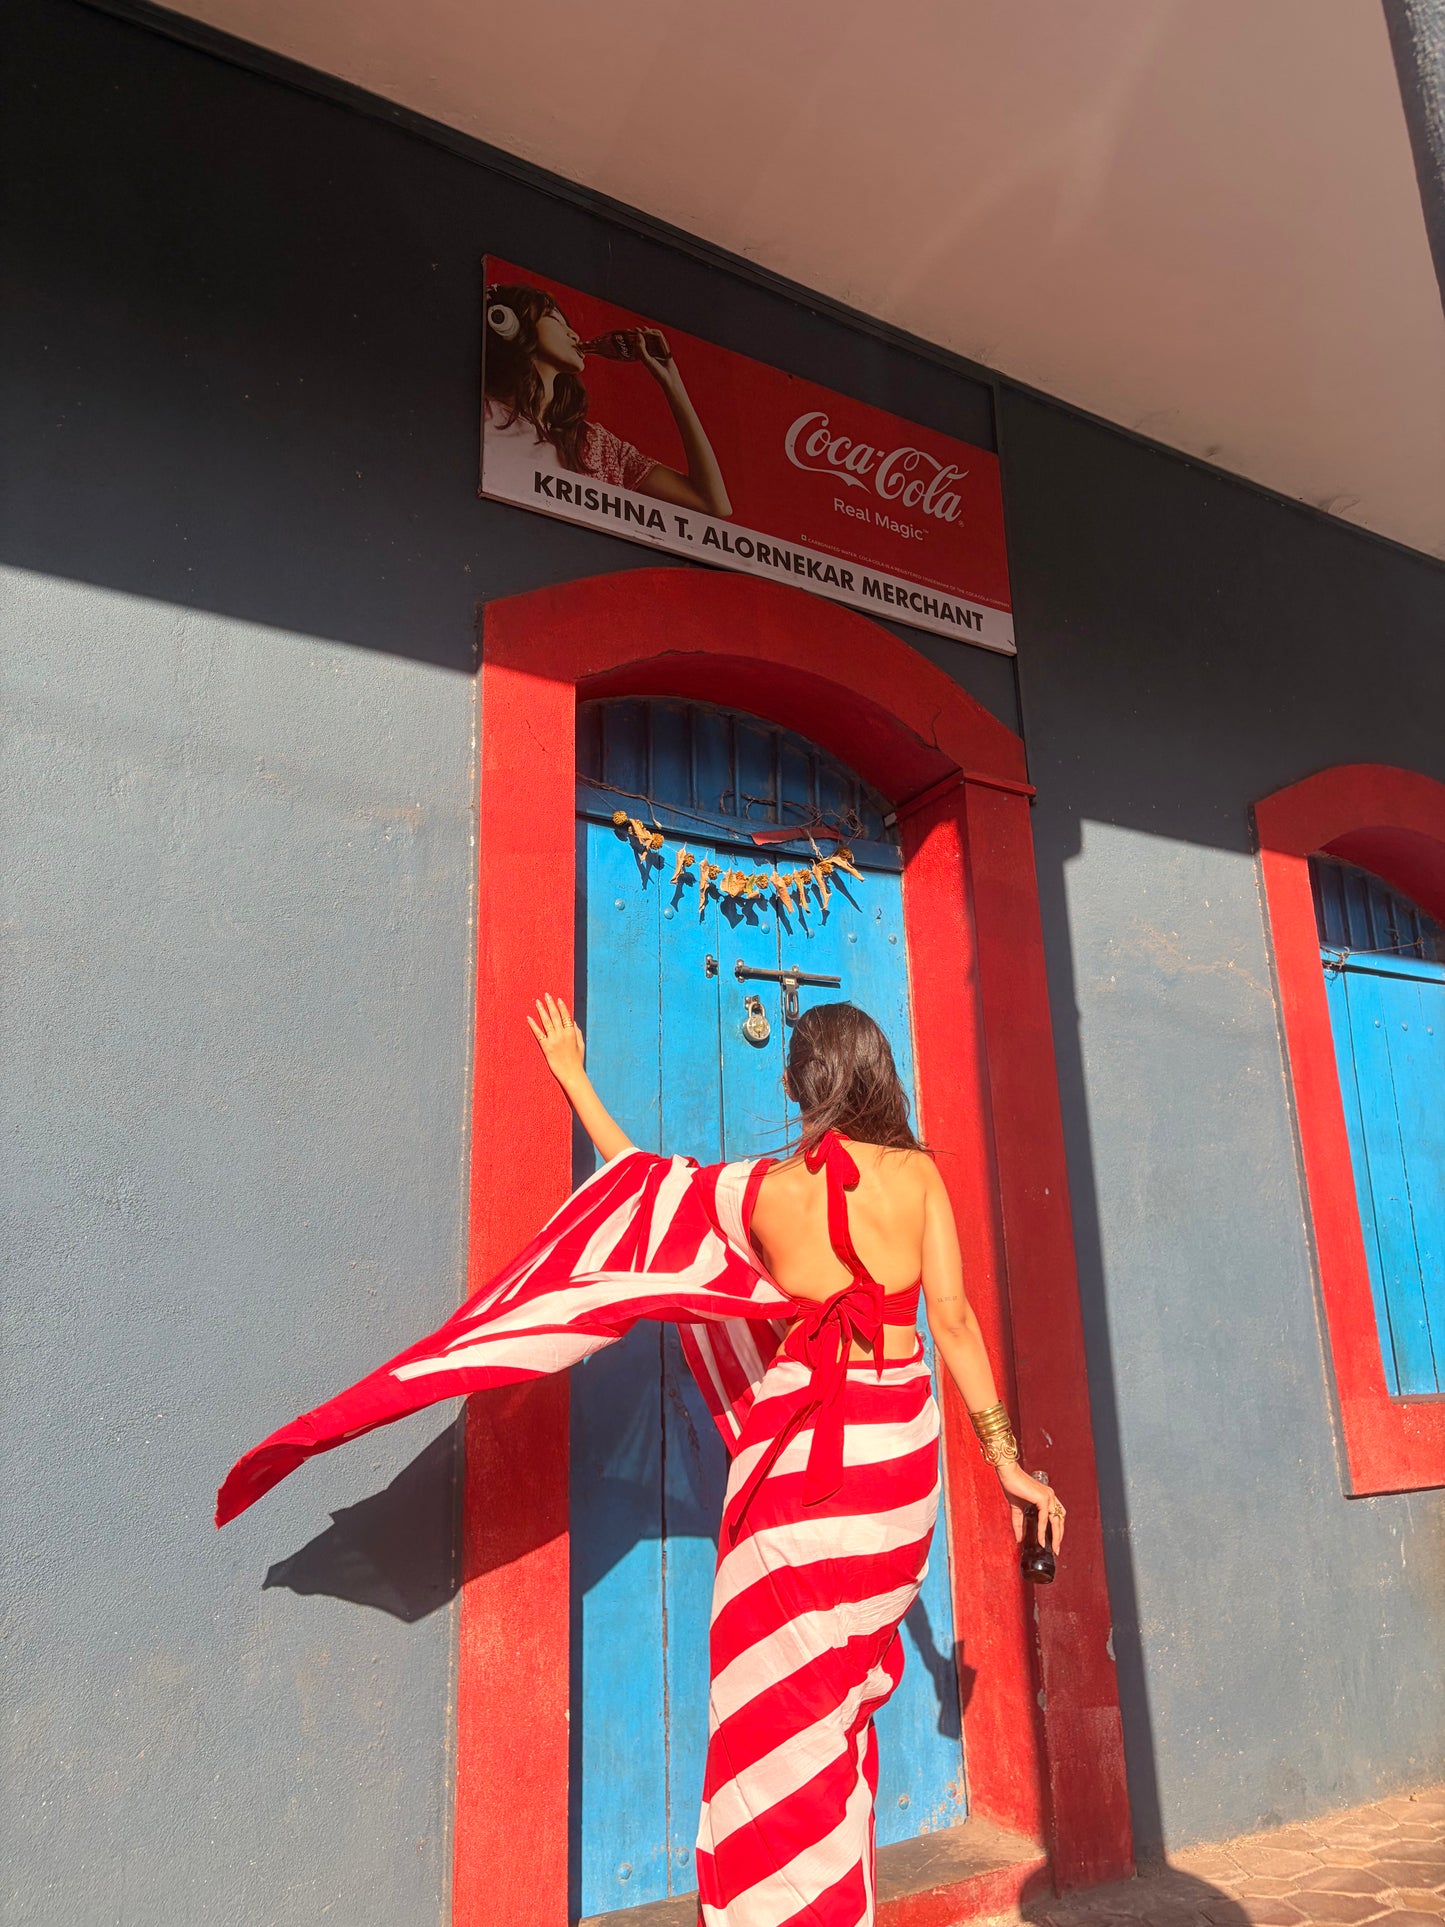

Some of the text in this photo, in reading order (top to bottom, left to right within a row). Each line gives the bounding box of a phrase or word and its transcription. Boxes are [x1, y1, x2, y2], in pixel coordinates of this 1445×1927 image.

[784, 411, 969, 523] Coca-Cola
[833, 498, 871, 523] Real
[534, 471, 983, 632] KRISHNA T. ALORNEKAR MERCHANT
